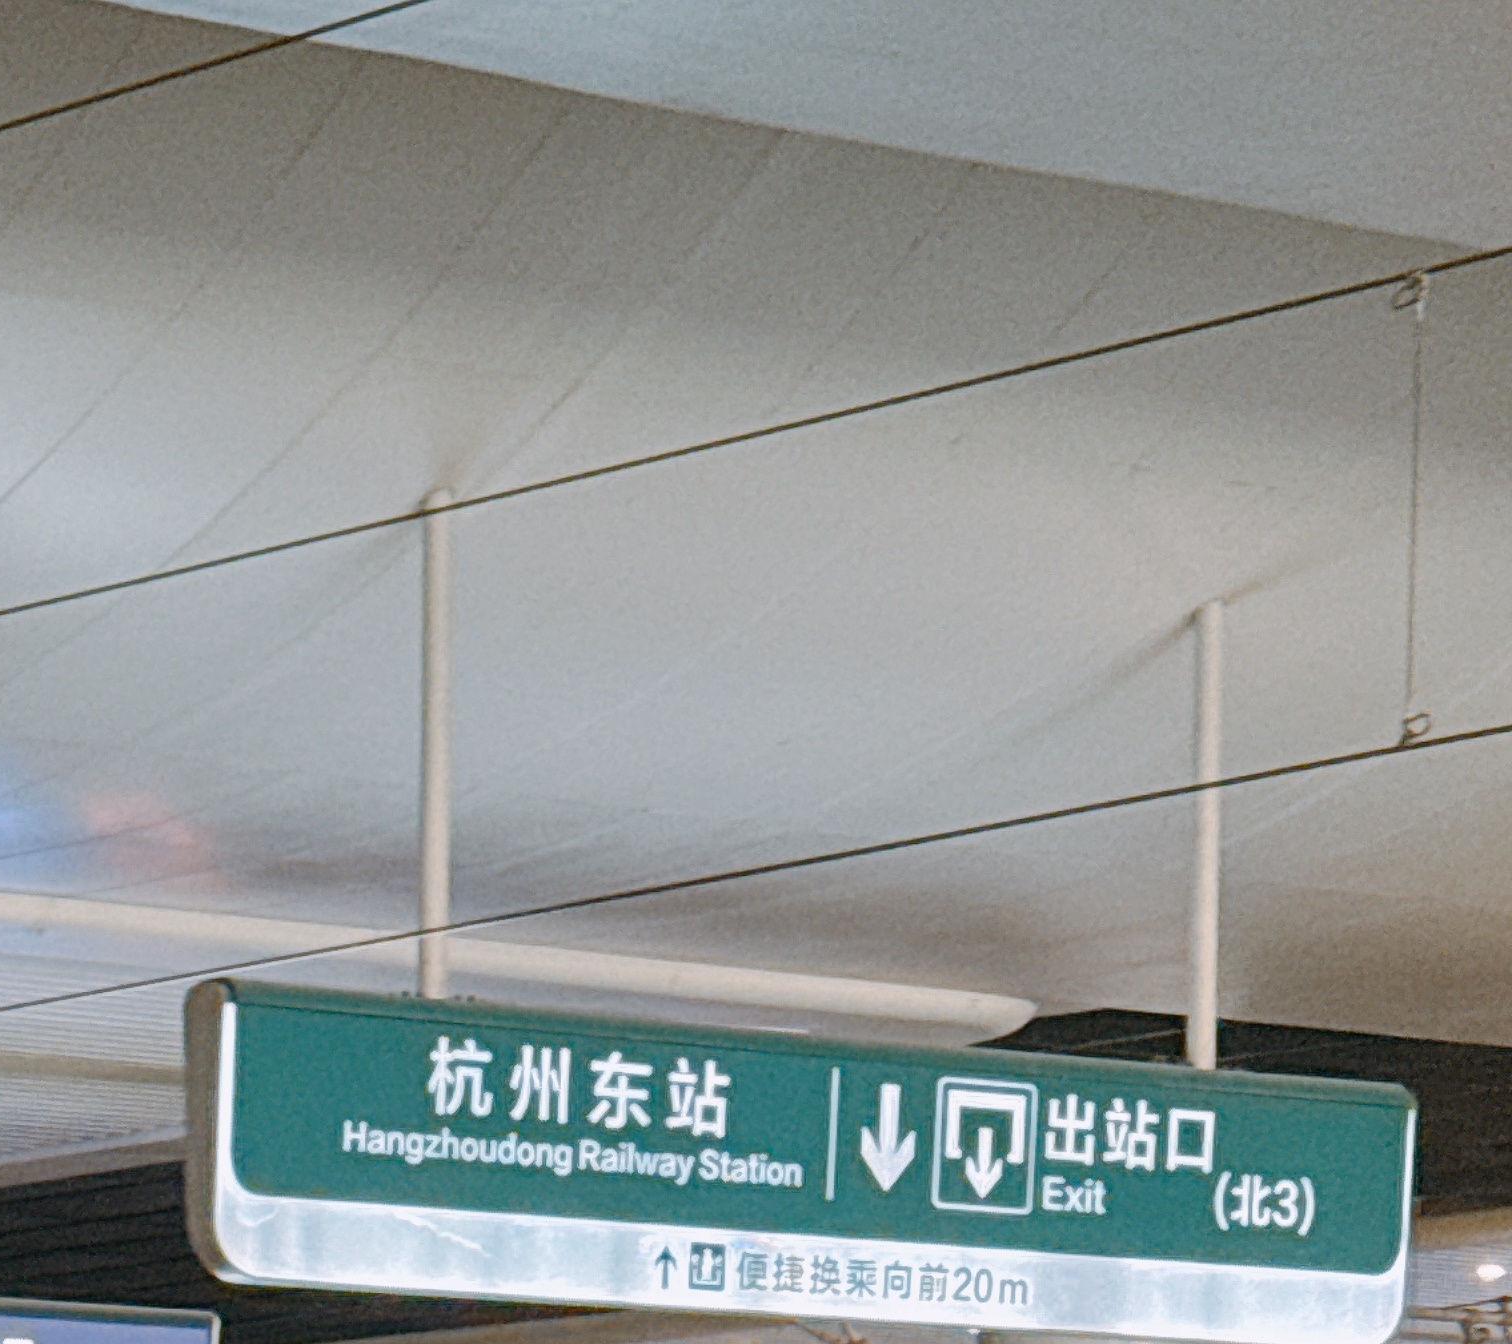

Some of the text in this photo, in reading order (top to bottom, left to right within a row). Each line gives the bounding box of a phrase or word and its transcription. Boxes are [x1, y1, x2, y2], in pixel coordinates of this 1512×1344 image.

[426, 1036, 731, 1140] 杭州东站
[341, 1119, 804, 1188] Hangzhoudong Railway Station
[1042, 1093, 1217, 1174] 出站口
[1042, 1176, 1107, 1216] Exit
[736, 1249, 1031, 1306] 便捷换乘向前20m
